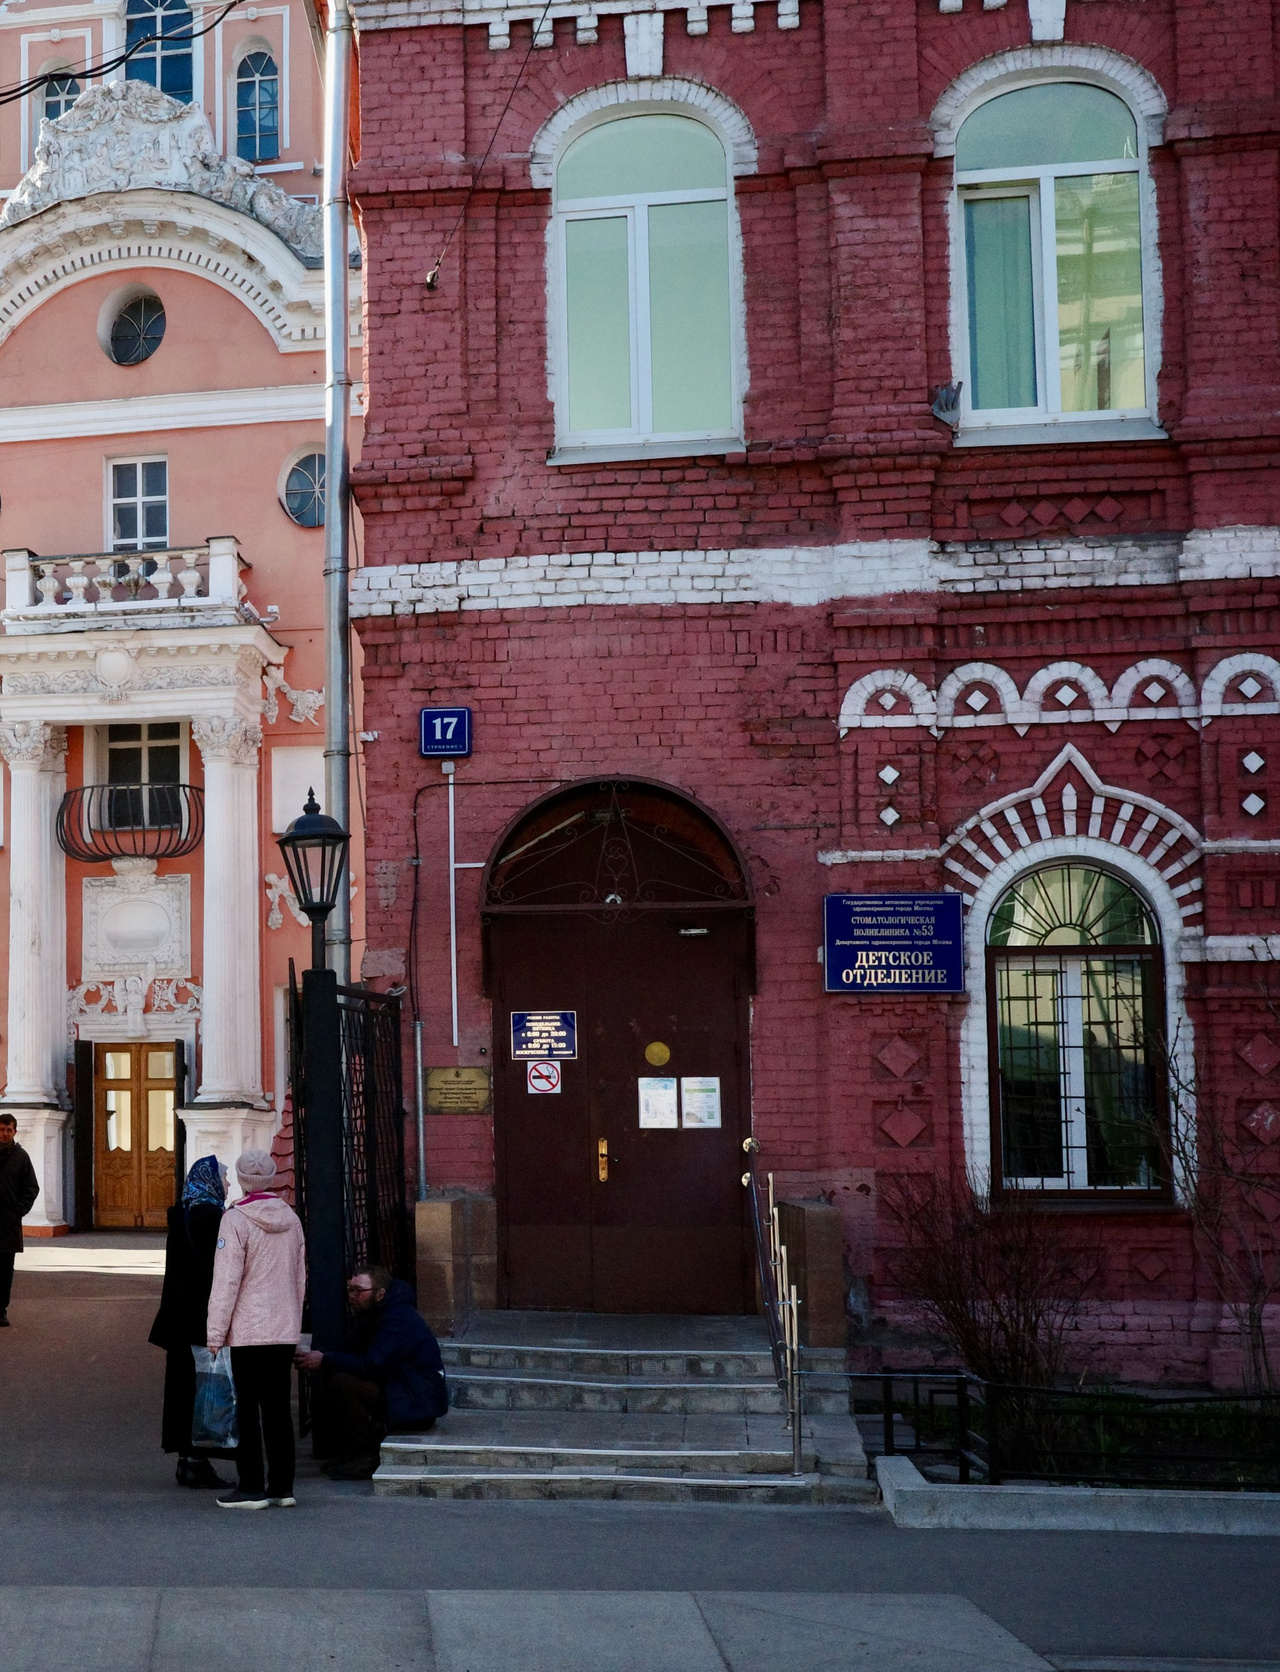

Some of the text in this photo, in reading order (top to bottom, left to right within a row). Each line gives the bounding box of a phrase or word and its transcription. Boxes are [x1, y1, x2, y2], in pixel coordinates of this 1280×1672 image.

[432, 717, 458, 740] 17
[851, 916, 935, 924] СТОМАТОЛОГИЧЕСКАЯ
[853, 928, 910, 936] ПОЛИКЛИНИКА
[855, 951, 933, 968] ДЕТСКОЕ
[842, 969, 947, 987] ОТДЕЛЕНИЕ
